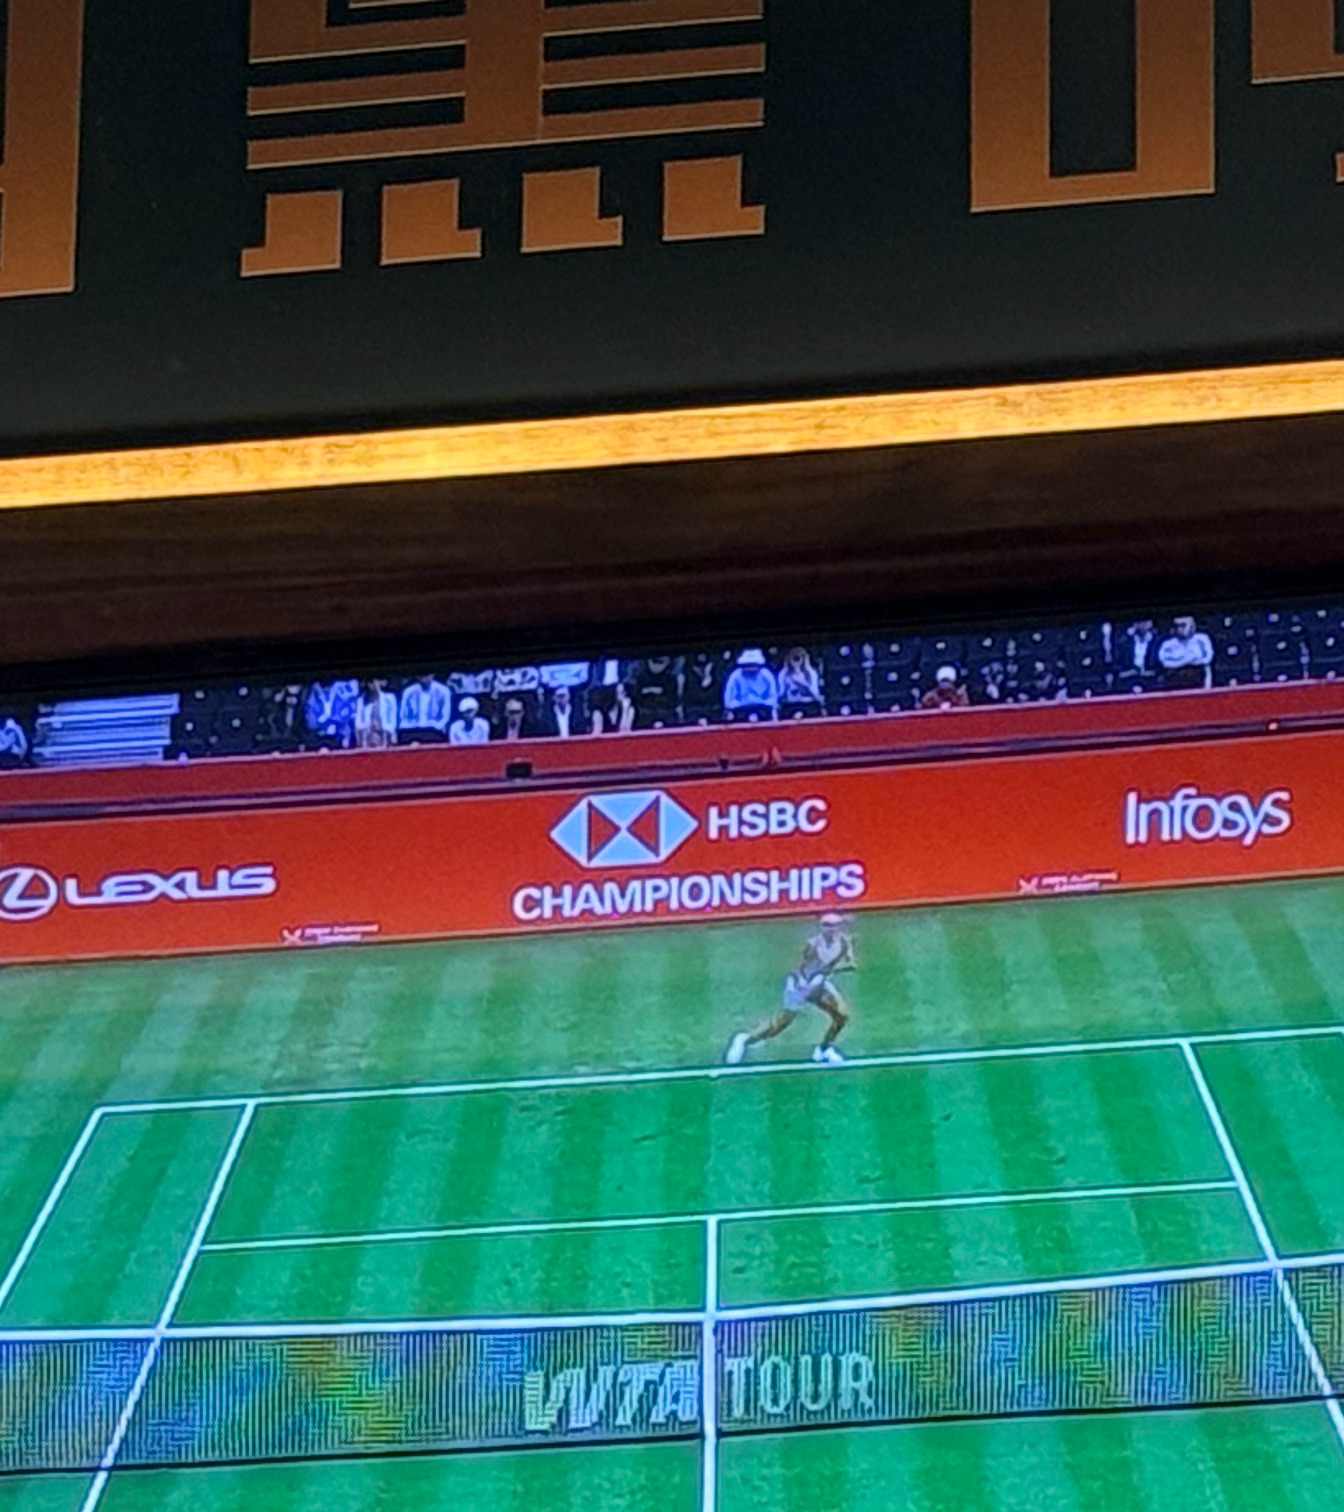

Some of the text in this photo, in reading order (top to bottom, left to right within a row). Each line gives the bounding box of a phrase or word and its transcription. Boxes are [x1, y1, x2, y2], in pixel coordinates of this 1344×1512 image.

[707, 799, 829, 841] HSBC
[1124, 788, 1292, 847] Infosys
[64, 864, 278, 907] LEXUS
[512, 864, 866, 922] CHAMPIONSHIPS
[524, 1352, 876, 1432] WTA TOUR
